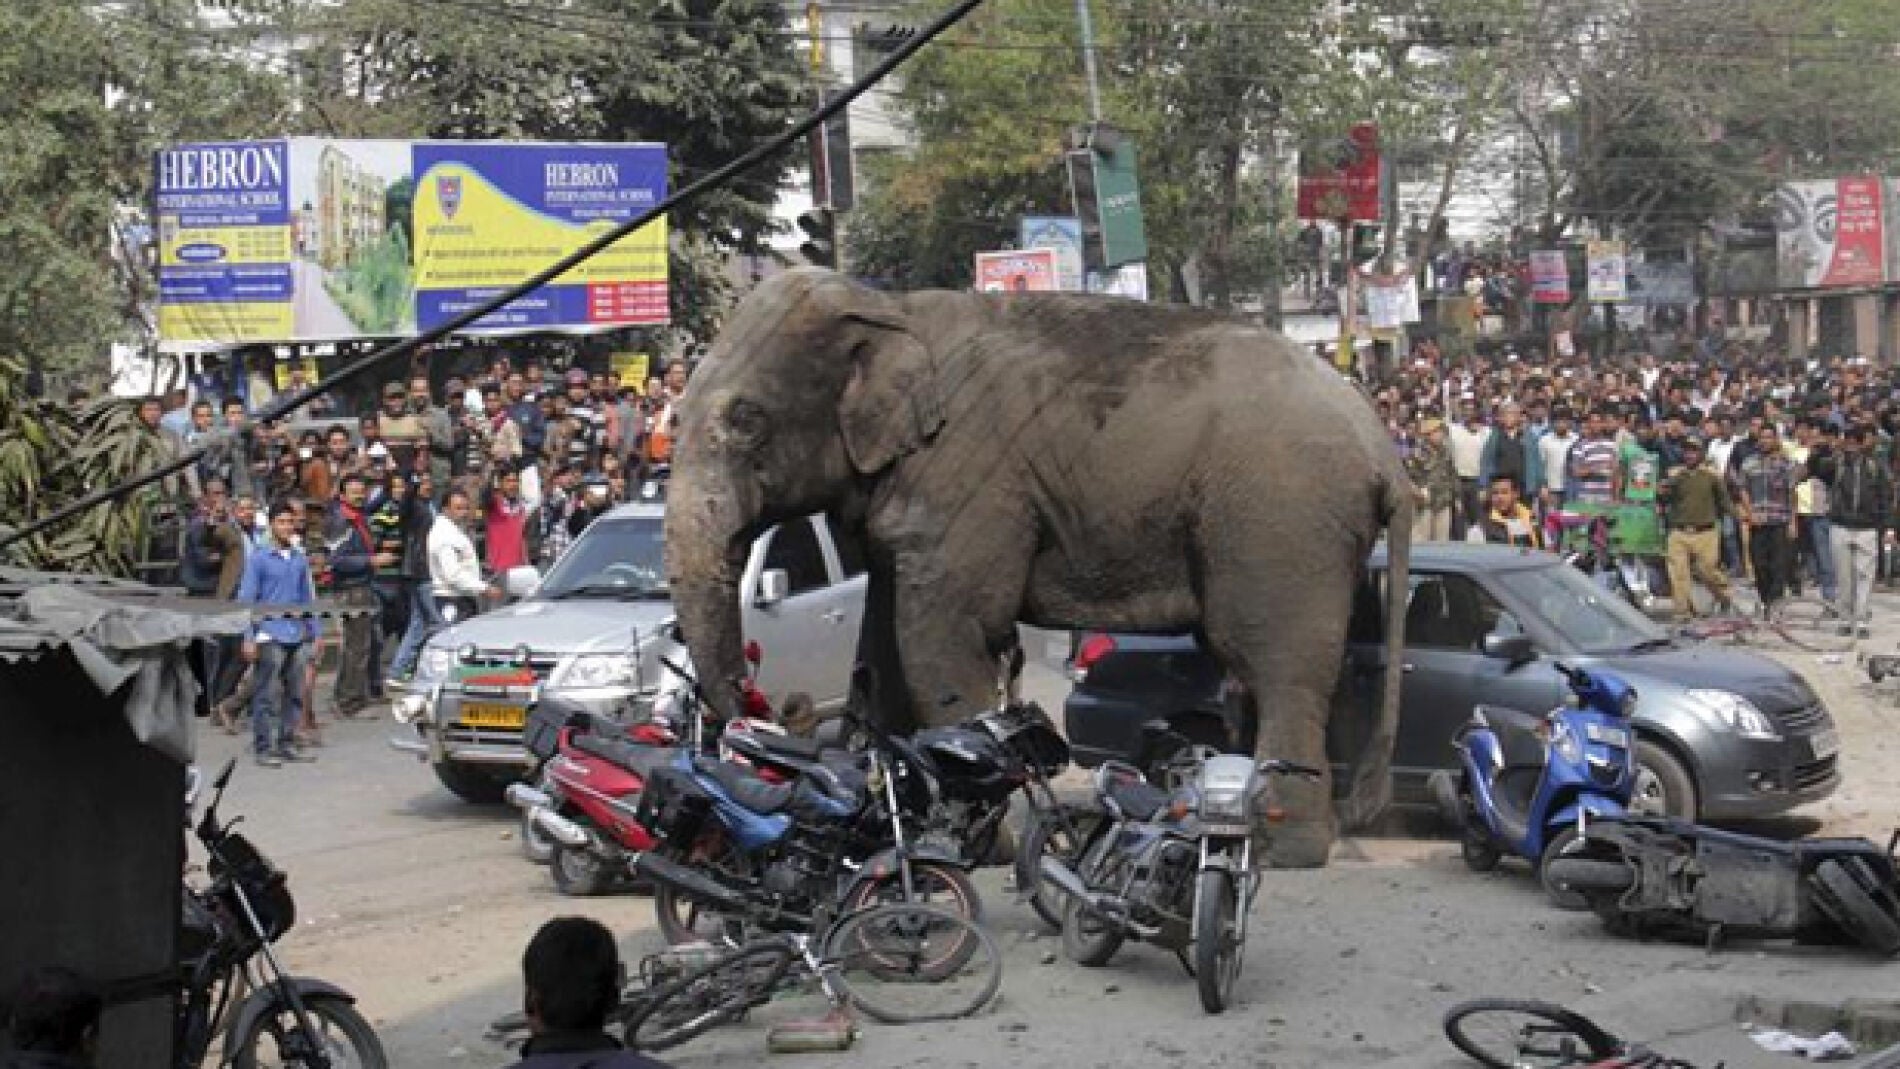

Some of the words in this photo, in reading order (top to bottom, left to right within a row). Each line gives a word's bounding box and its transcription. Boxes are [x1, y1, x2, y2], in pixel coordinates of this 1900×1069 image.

[159, 147, 282, 189] HEBRON
[545, 163, 619, 186] HEBRON
[157, 193, 238, 208] INTERNATIONAL
[240, 192, 281, 206] SCHOOL
[544, 191, 616, 202] INTERNATIONAL
